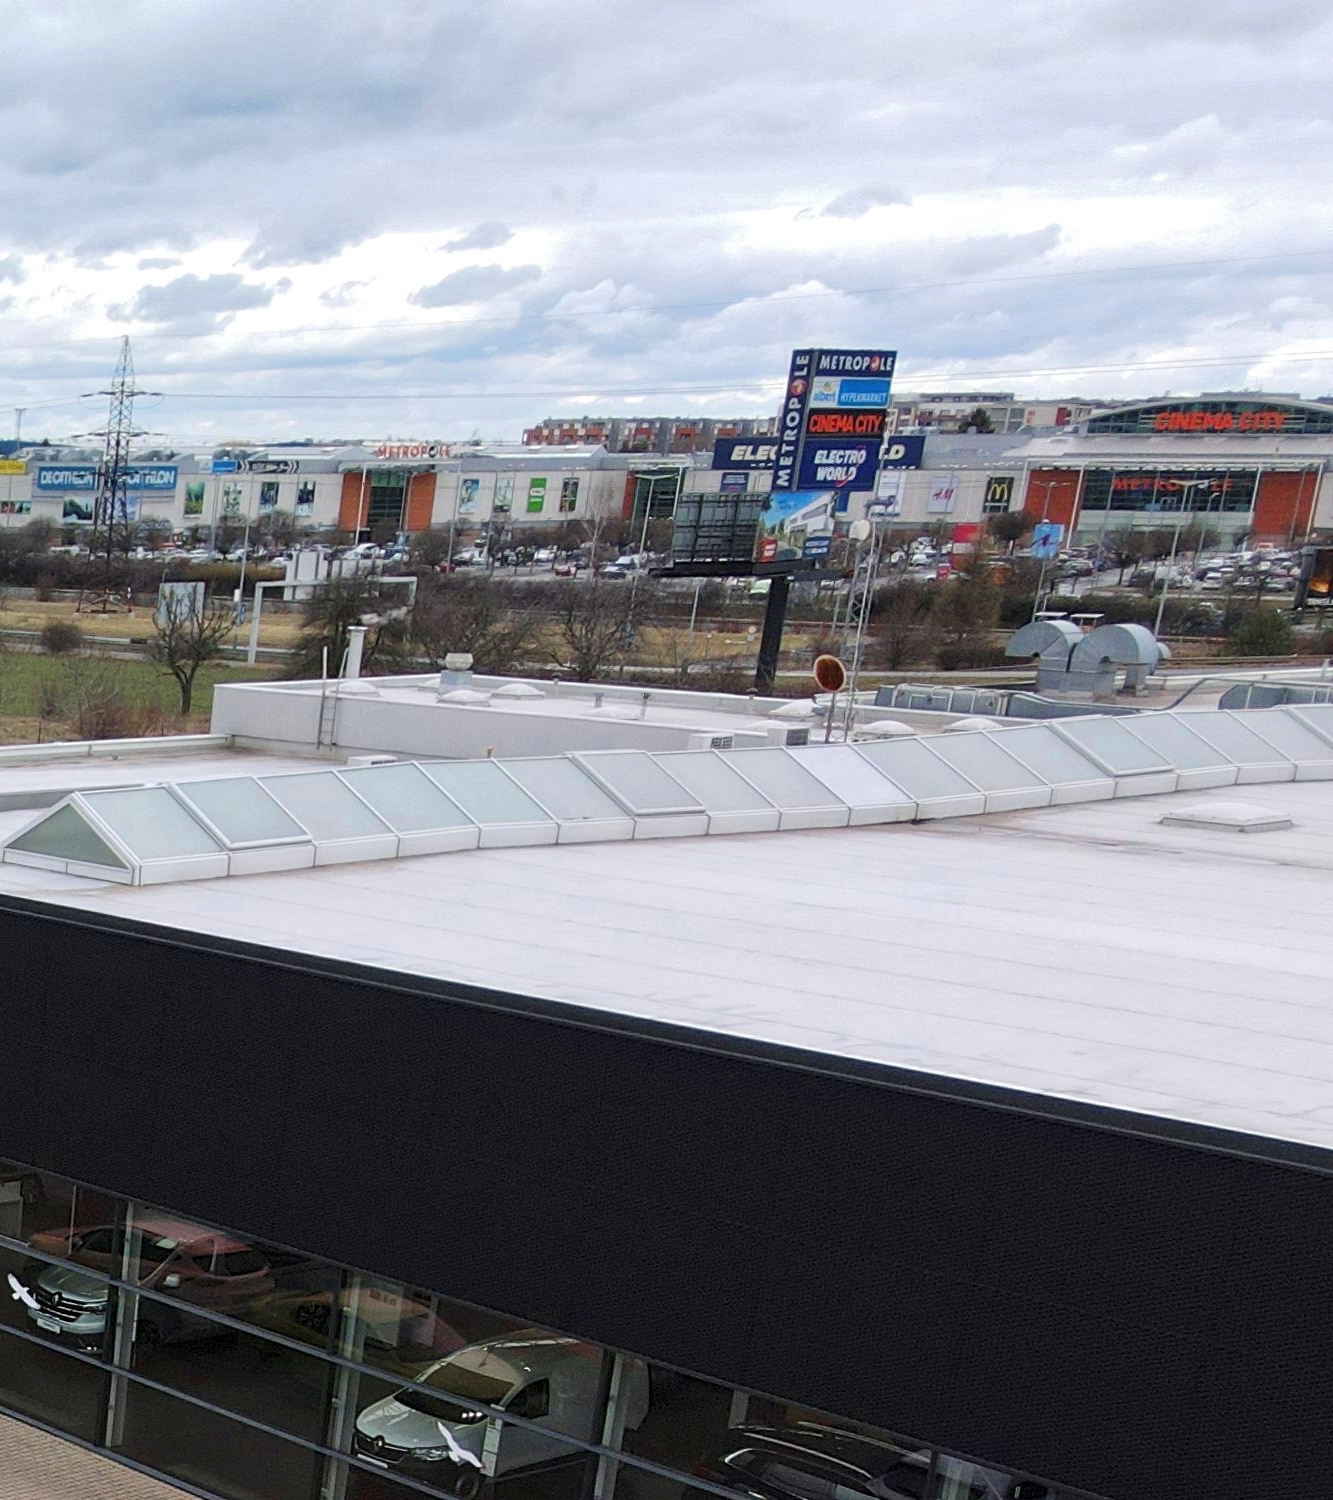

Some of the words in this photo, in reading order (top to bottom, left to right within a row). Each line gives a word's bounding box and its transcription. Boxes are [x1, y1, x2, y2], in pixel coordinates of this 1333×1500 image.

[819, 355, 893, 372] METROPOLE
[776, 354, 810, 487] METROPOLE
[809, 415, 854, 433] CINEMA
[855, 414, 882, 432] CITY
[1153, 412, 1232, 432] CINEMA
[1237, 411, 1285, 431] CITY
[376, 445, 452, 458] METROPOLE
[814, 450, 866, 465] ELECTRO
[816, 465, 857, 482] WORLD
